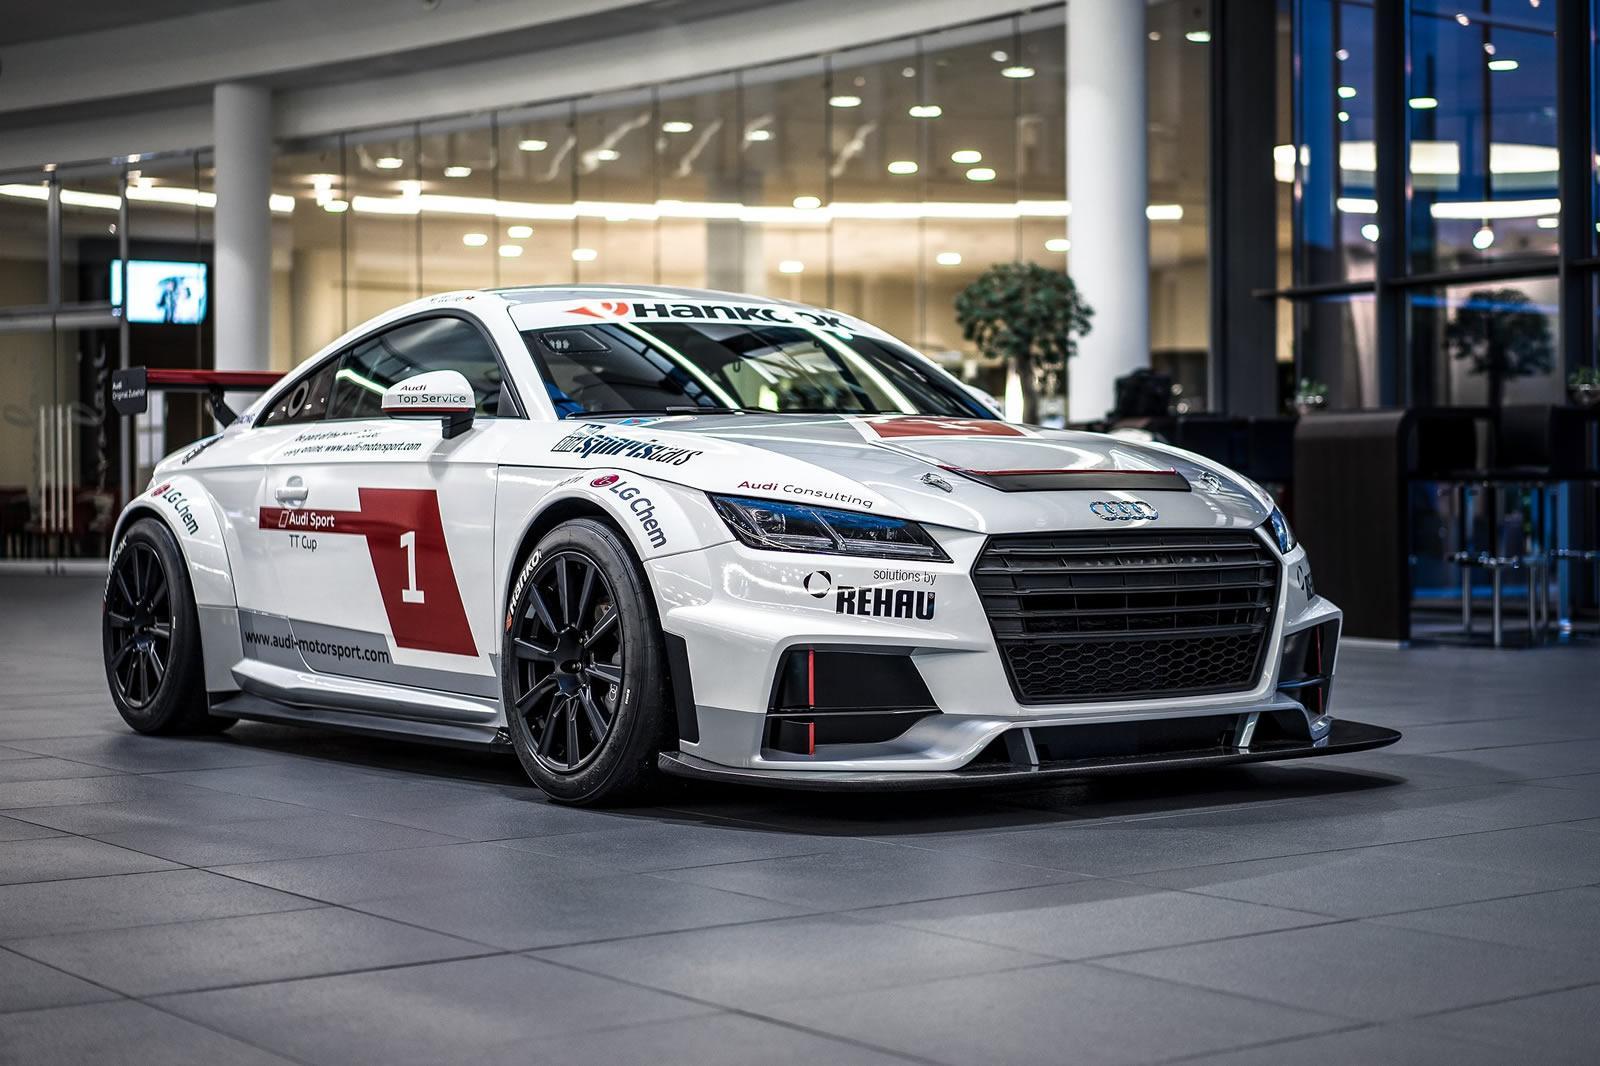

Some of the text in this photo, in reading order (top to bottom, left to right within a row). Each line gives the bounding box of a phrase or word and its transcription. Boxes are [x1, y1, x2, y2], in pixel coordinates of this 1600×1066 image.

[397, 393, 466, 404] Top Service
[738, 480, 873, 509] Audi Consulting
[162, 488, 199, 535] LG Chem
[289, 512, 335, 529] Audi Sport
[609, 481, 667, 549] LG Chem
[289, 535, 317, 551] TT Cup
[400, 531, 425, 604] 1
[924, 571, 937, 586] by
[835, 585, 936, 620] REHAU
[244, 630, 390, 664] www.audi-motorsport.com
